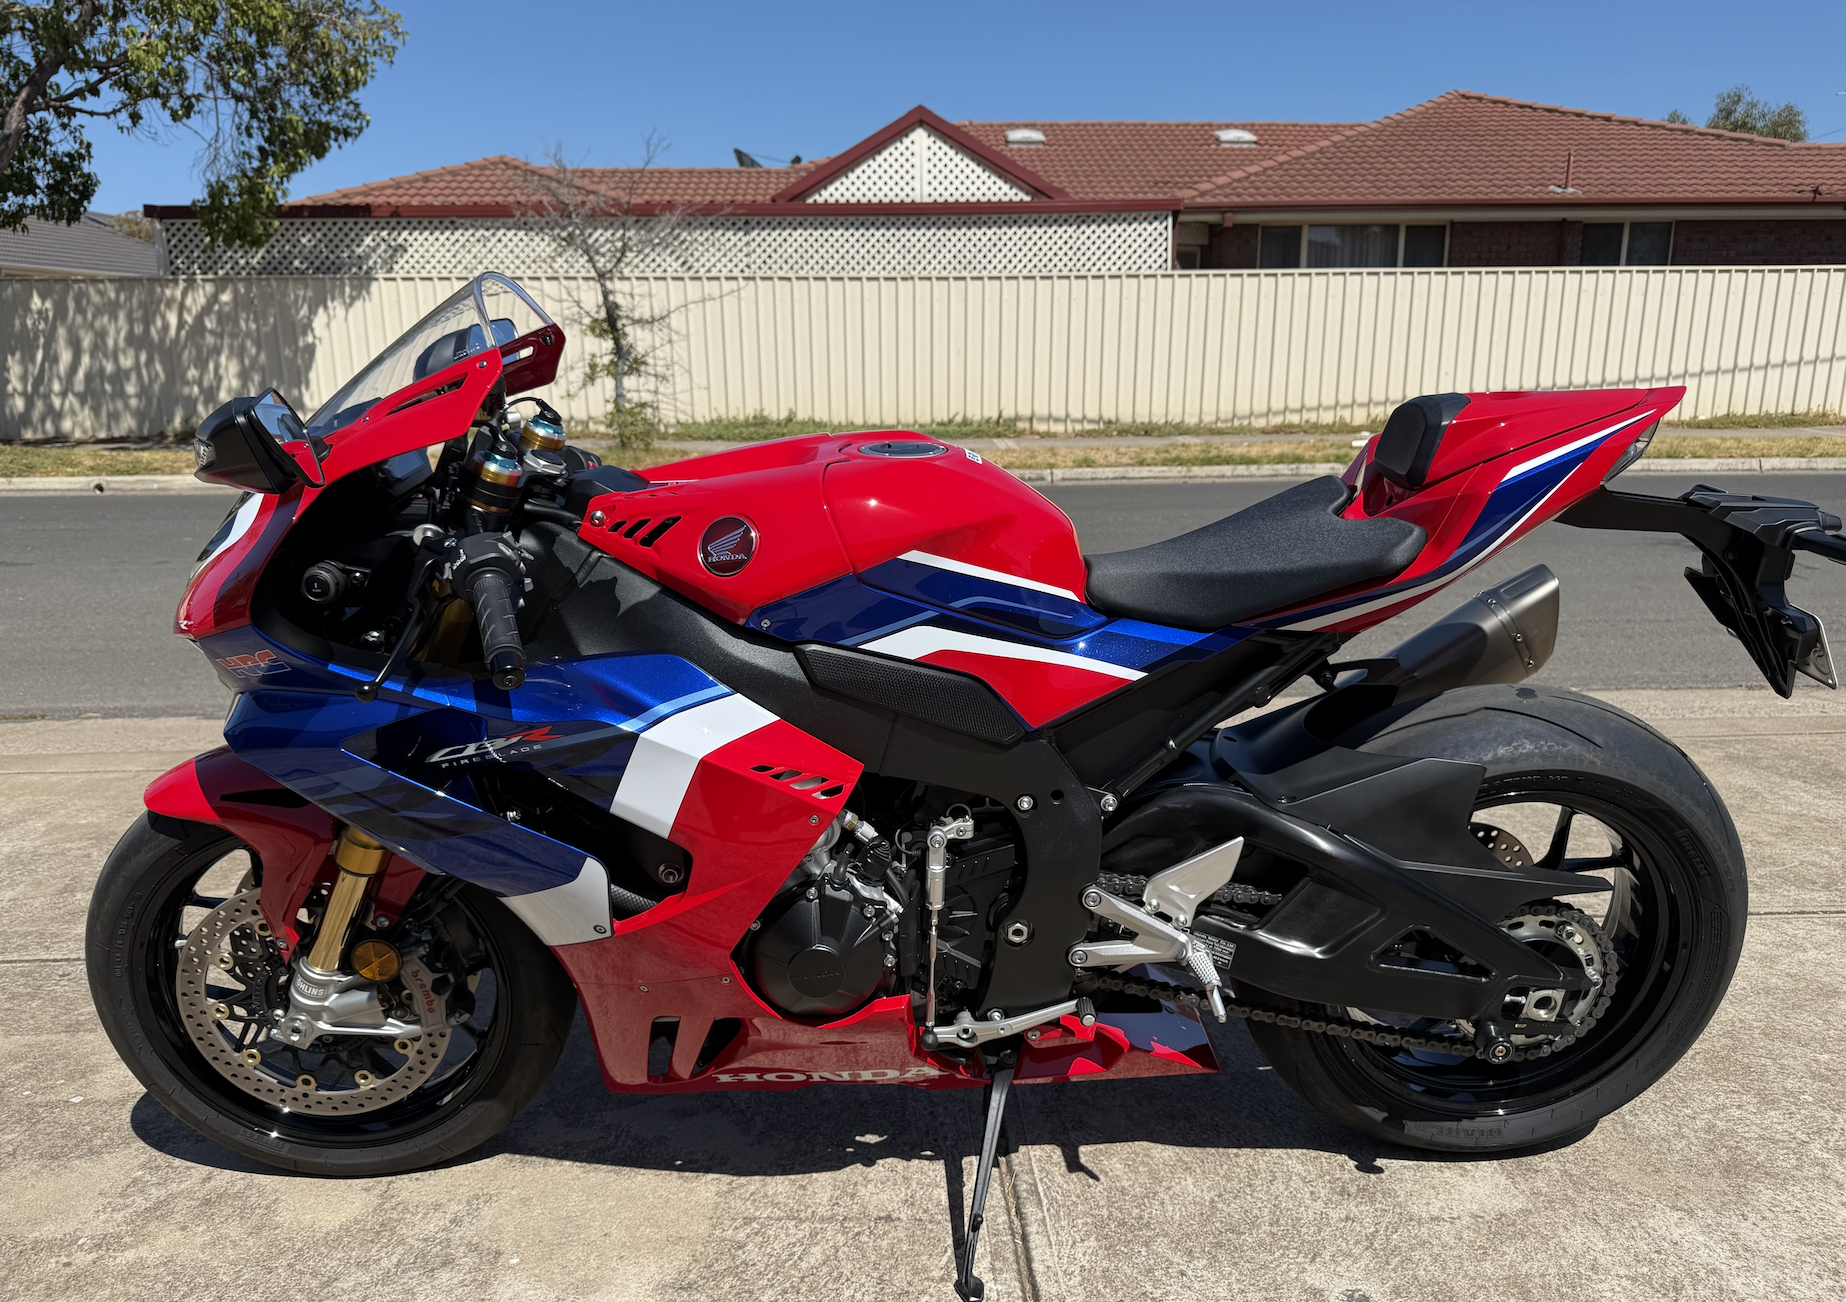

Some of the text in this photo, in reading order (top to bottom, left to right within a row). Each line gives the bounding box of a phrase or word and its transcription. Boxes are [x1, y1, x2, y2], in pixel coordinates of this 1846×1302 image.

[708, 553, 748, 563] HONDA
[216, 649, 291, 679] HRC
[425, 726, 564, 763] CBR
[441, 744, 543, 768] FIREBLADE
[1673, 827, 1712, 878] PIRELLI
[411, 969, 436, 1013] brembo
[711, 1066, 949, 1083] HONDA
